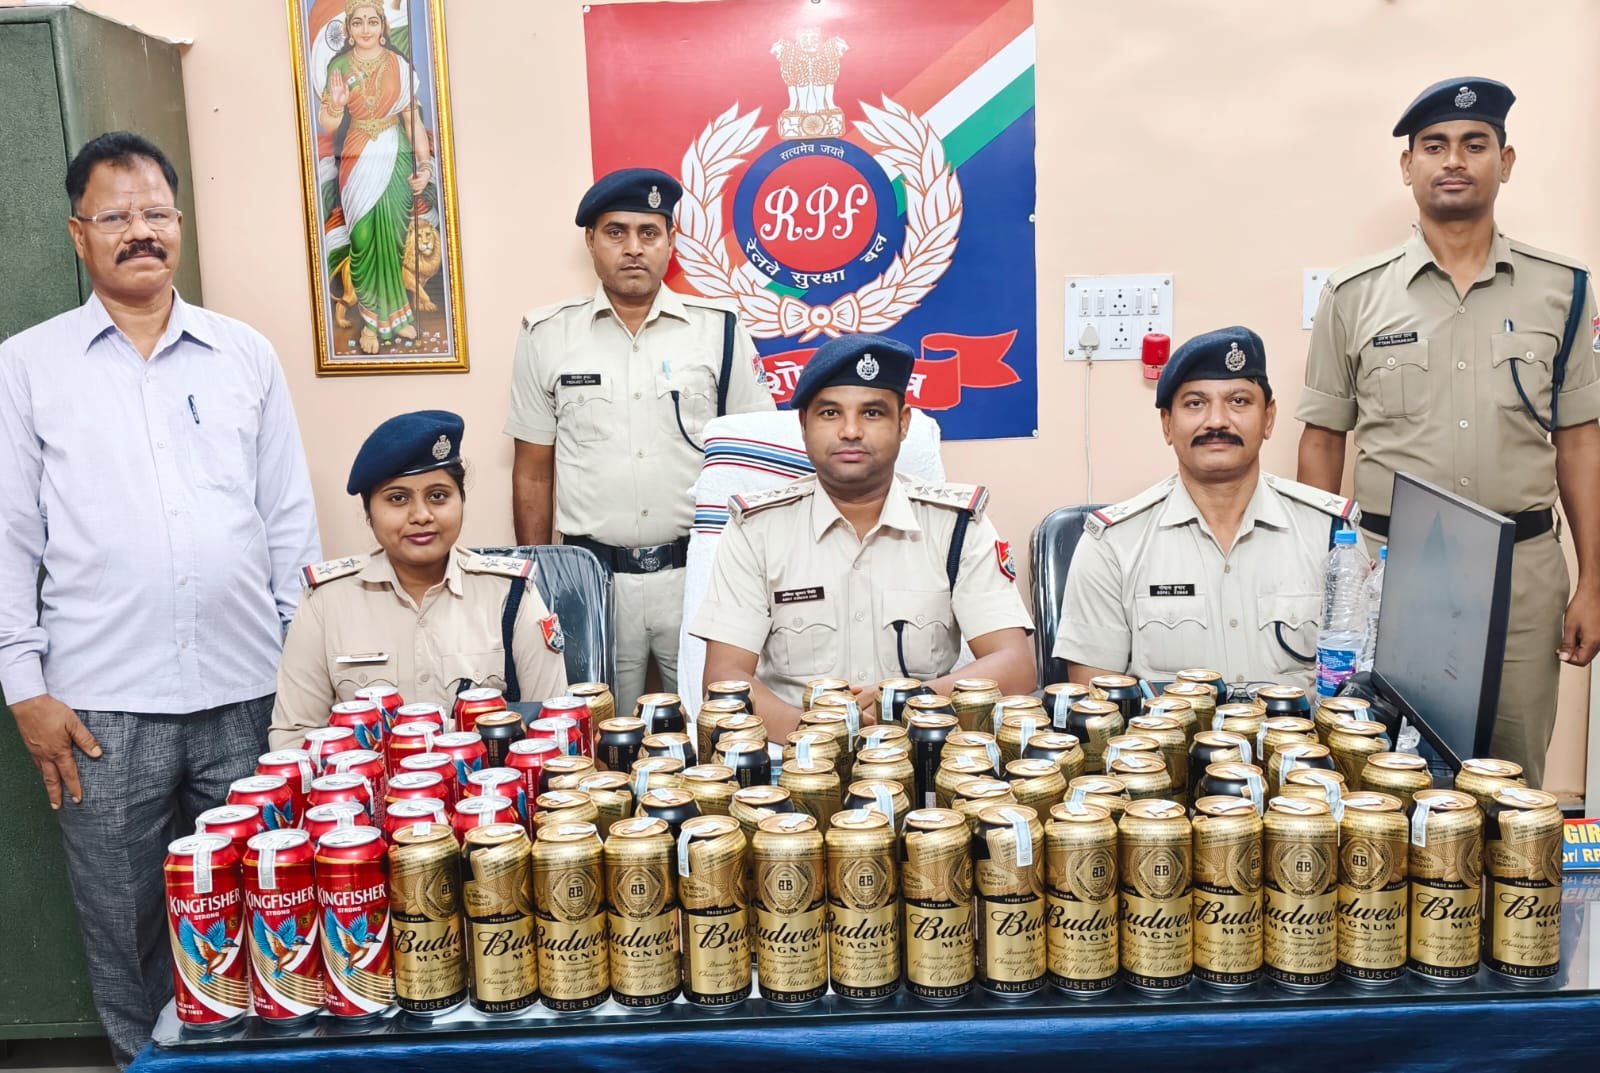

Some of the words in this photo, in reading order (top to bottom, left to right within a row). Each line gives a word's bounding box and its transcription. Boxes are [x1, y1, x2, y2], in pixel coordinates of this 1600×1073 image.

[779, 143, 815, 160] सत्यमेव
[820, 144, 845, 159] जयते
[746, 237, 781, 276] रेलवे
[790, 269, 846, 289] सुरक्षा
[169, 887, 241, 917] KINGFISHER
[245, 885, 316, 910] KINGFISHER
[317, 882, 386, 908] KINGFISHER
[194, 912, 219, 921] STRONG
[265, 909, 290, 917] STRONG
[1269, 920, 1333, 935] MAGNUM
